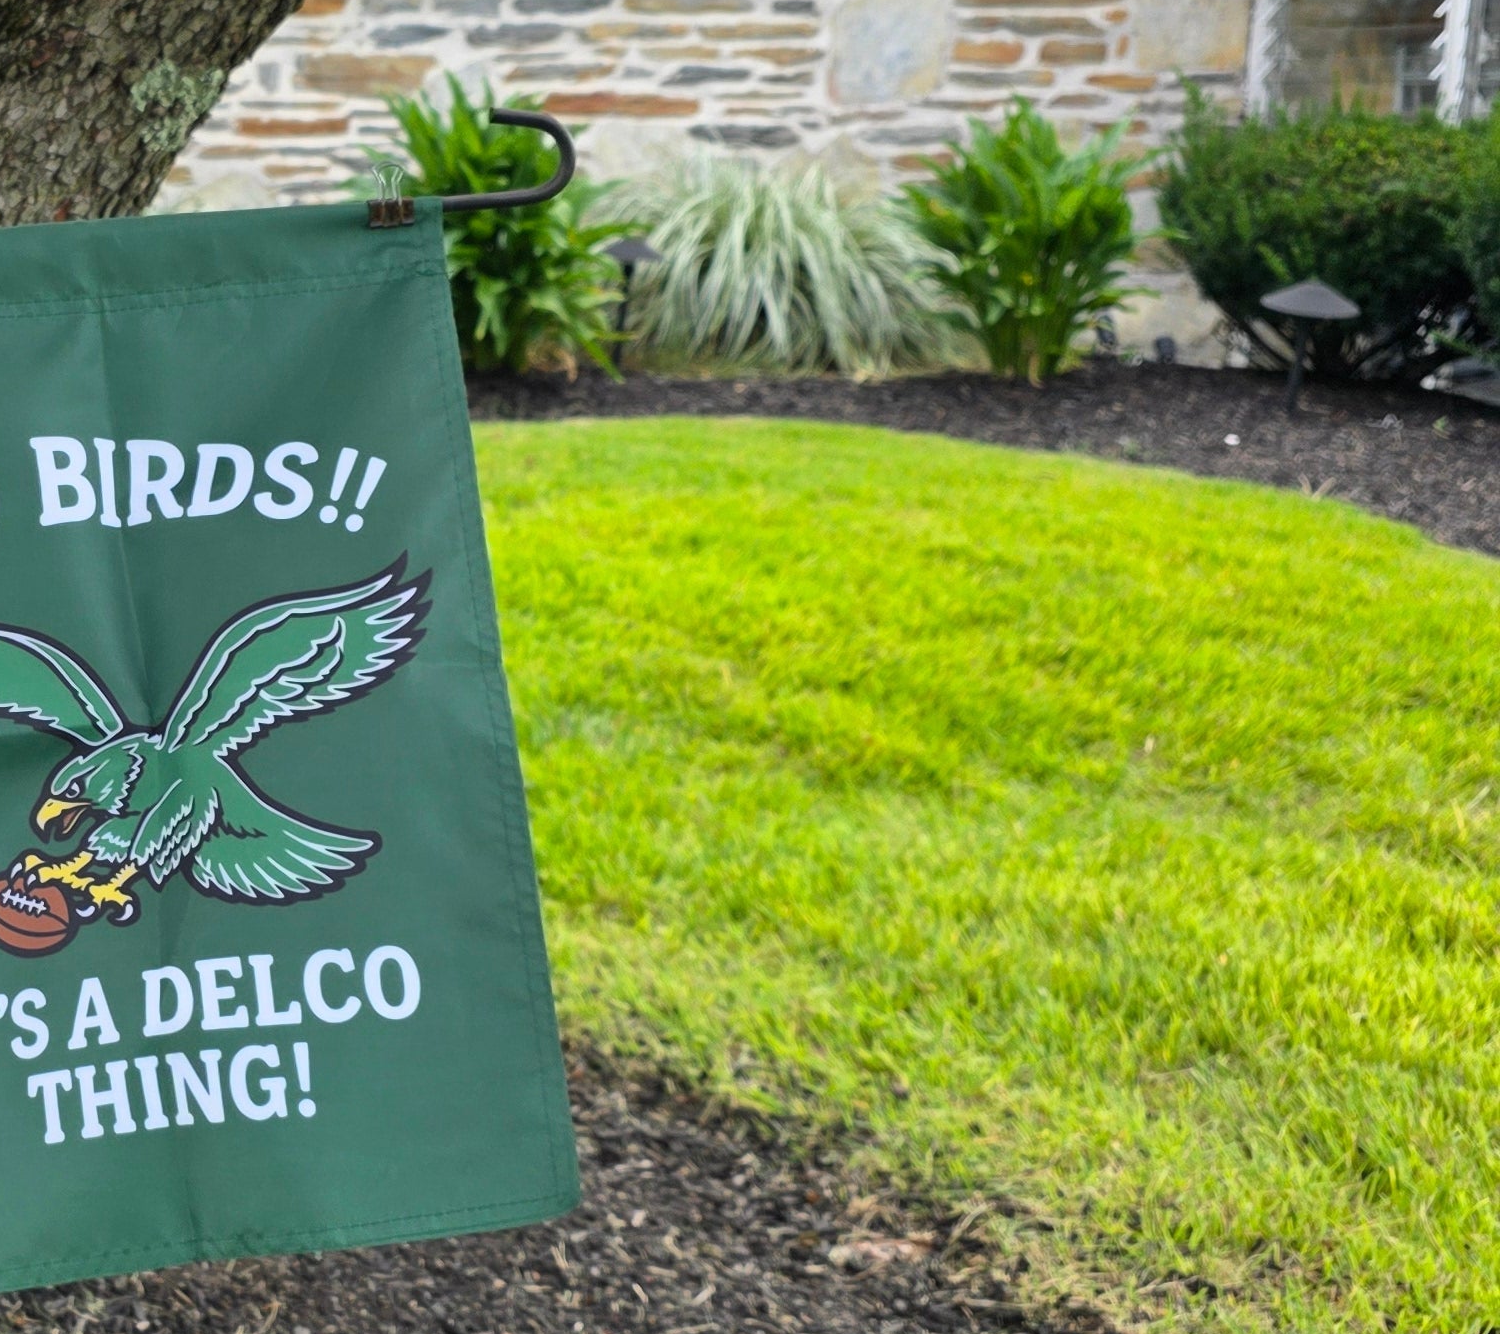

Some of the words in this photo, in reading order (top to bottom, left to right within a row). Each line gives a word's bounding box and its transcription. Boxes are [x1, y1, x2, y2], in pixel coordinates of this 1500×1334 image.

[28, 435, 388, 533] BIRDS!!
[67, 976, 121, 1051] A
[140, 944, 422, 1038] DELCO
[26, 1040, 318, 1146] THING!
